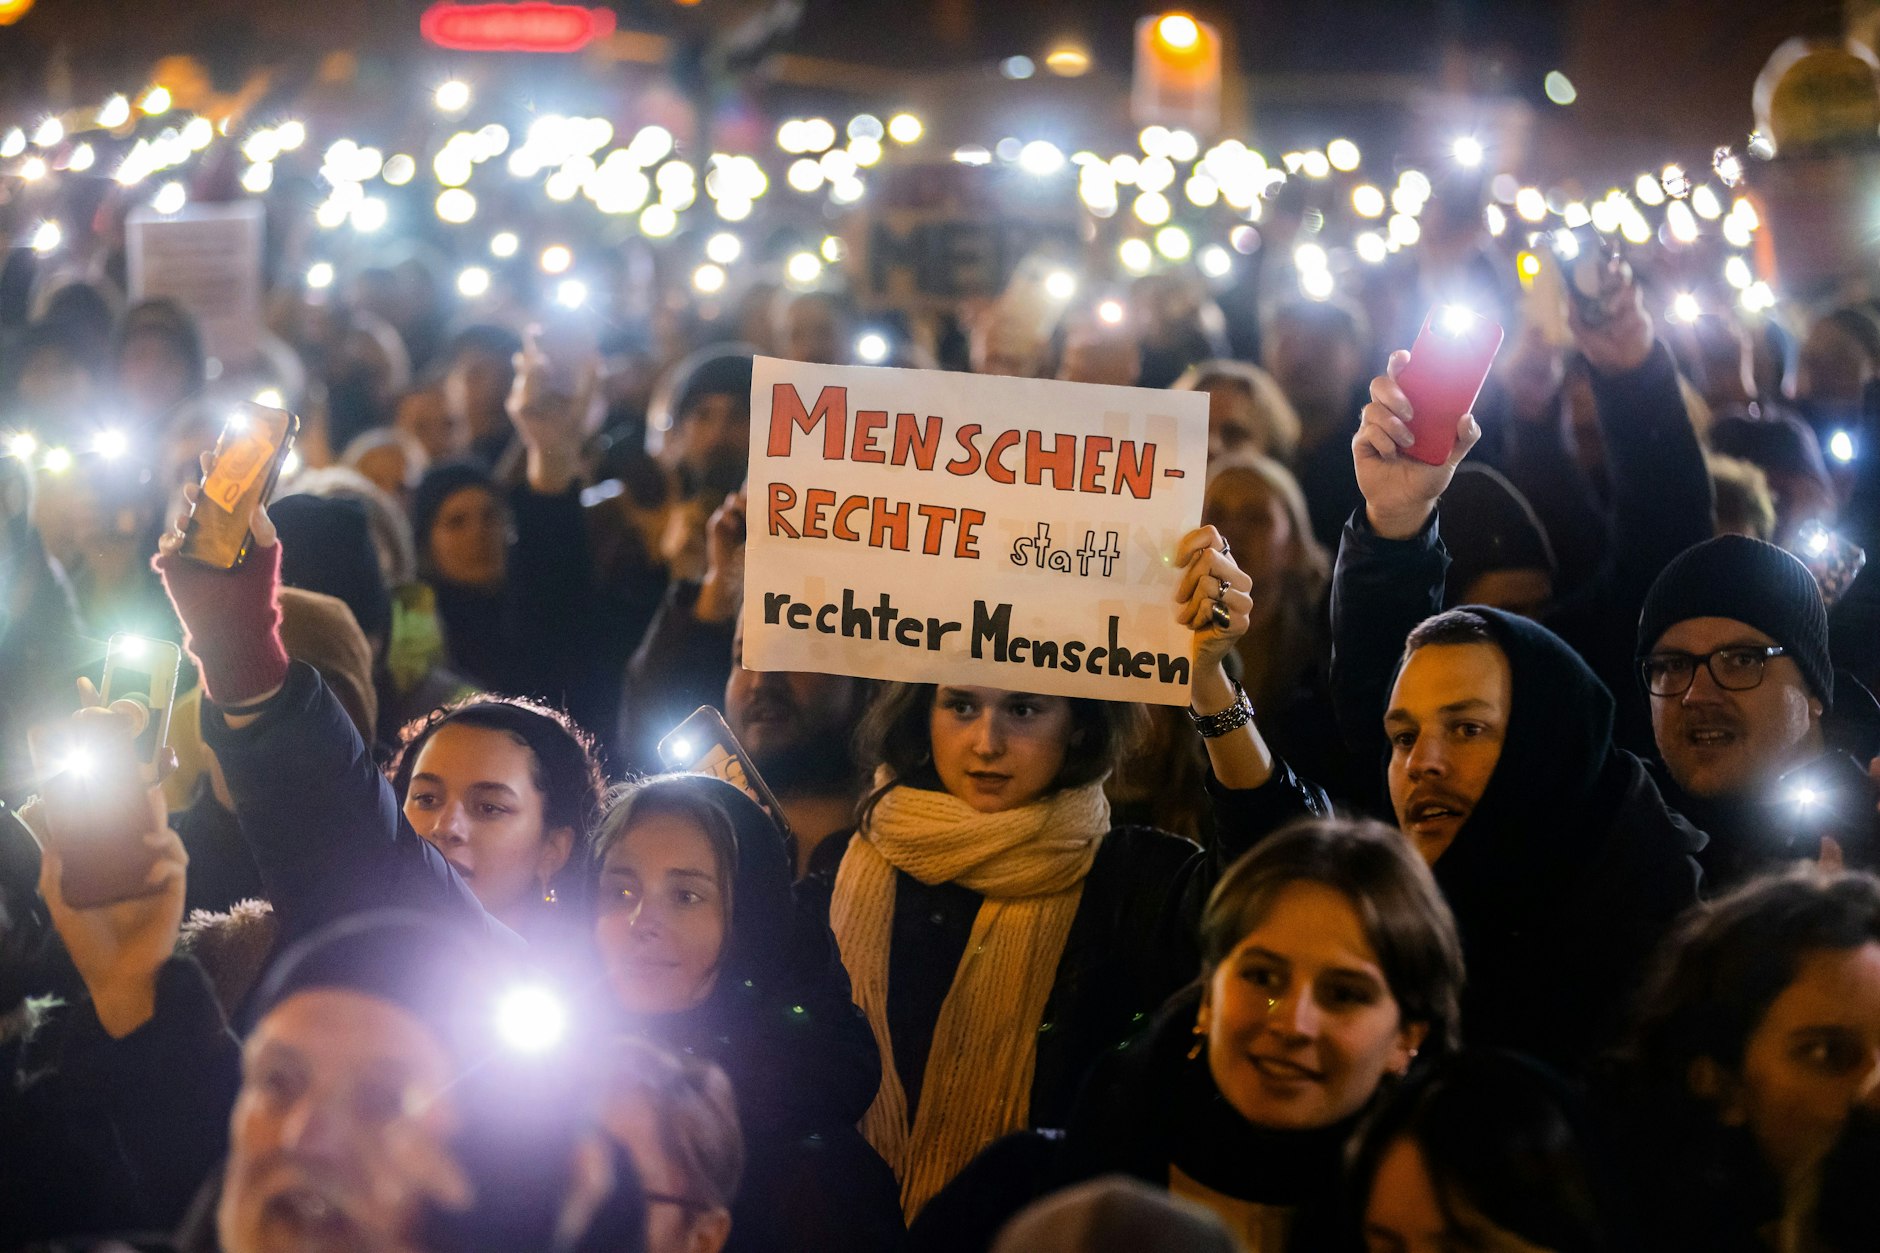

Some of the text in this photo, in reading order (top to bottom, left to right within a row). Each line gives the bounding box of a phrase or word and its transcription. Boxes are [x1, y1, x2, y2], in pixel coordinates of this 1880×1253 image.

[767, 383, 1184, 499] MENSCHEN-
[768, 482, 1120, 577] RECHTE statt
[764, 589, 1190, 684] rechter Menschen
